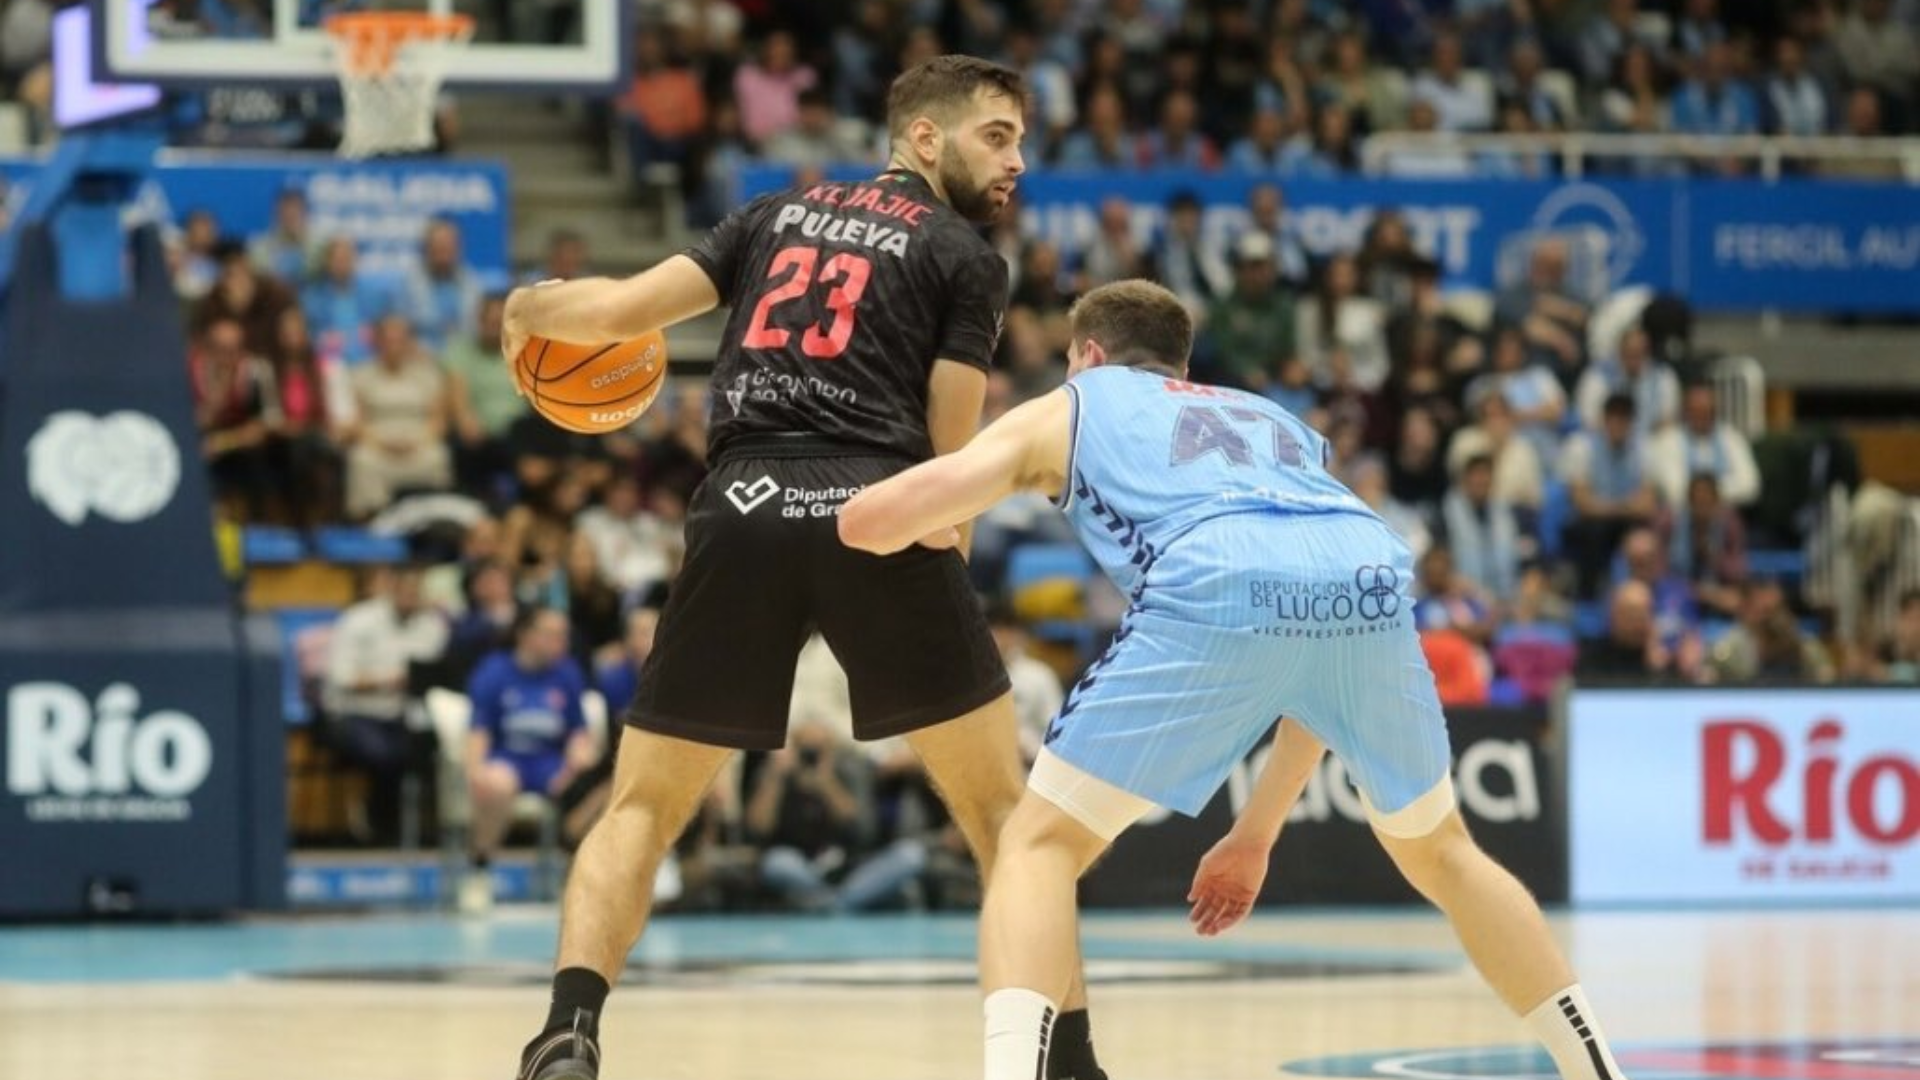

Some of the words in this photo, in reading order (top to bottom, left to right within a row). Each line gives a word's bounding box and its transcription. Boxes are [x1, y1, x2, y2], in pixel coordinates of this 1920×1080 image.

[773, 203, 909, 259] PULEVA
[741, 245, 872, 359] 23
[1170, 404, 1304, 469] 47
[781, 503, 806, 519] de
[1252, 594, 1274, 608] DE
[1276, 594, 1353, 622] LUGO
[1253, 620, 1402, 640] VICEPRESIDENCIA
[1700, 718, 1920, 848] Río
